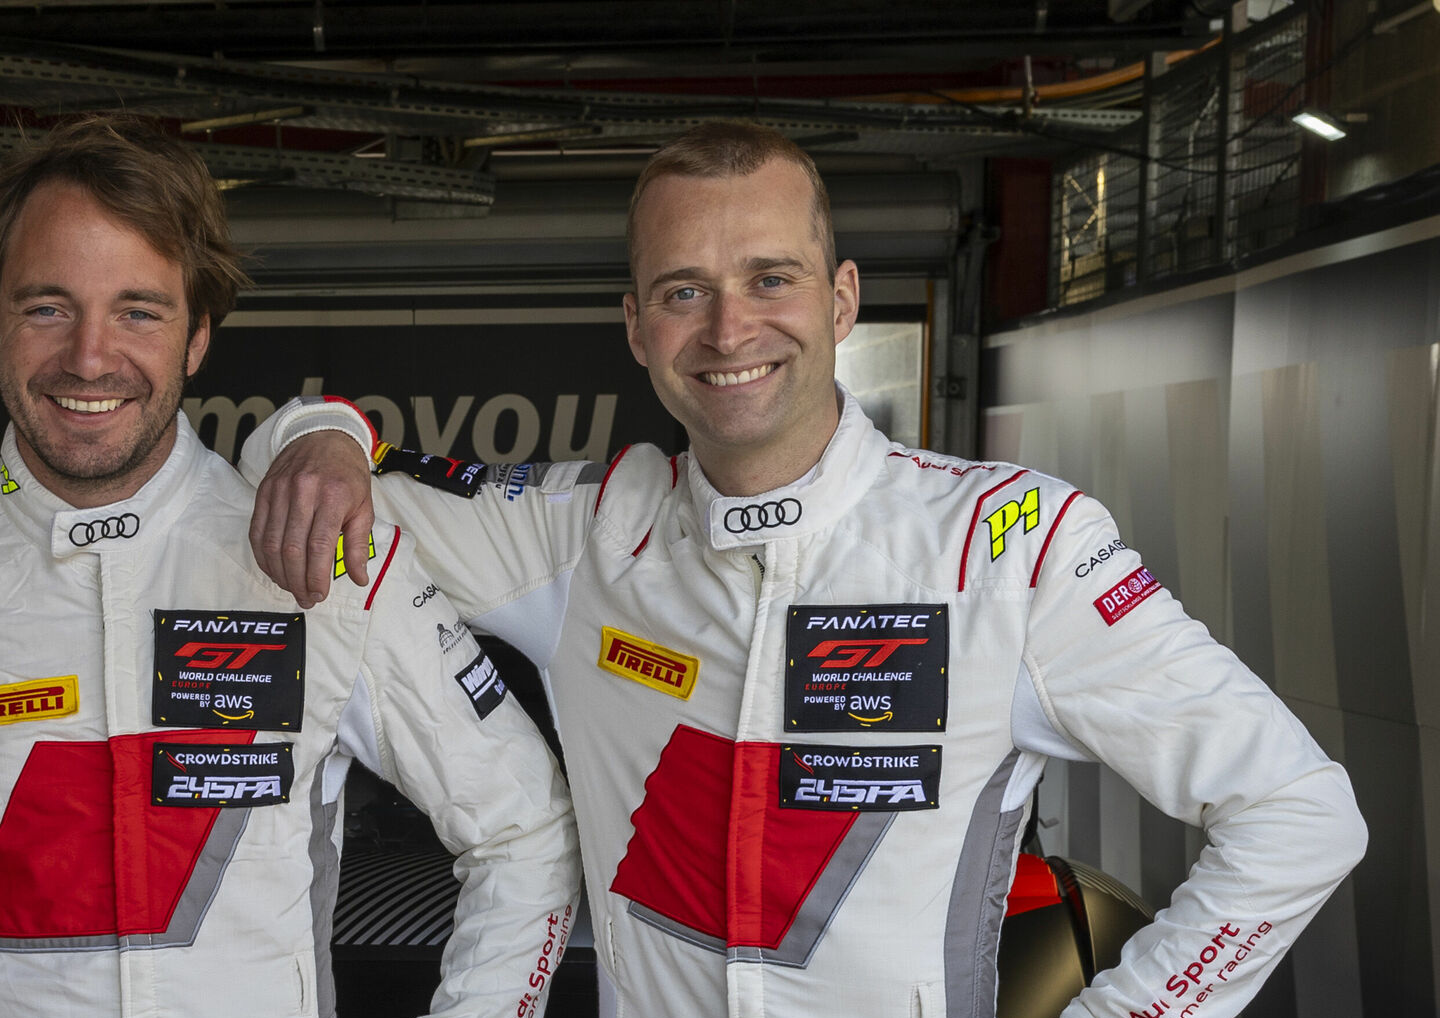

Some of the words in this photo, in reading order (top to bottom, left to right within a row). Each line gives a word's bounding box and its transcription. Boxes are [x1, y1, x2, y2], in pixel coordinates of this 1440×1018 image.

[981, 487, 1040, 563] P1
[1102, 585, 1133, 613] DER
[173, 620, 288, 635] FANATEC
[806, 615, 930, 630] FANATEC
[174, 642, 288, 669] GT
[806, 638, 930, 668] GT
[606, 637, 687, 688] PIRELLI
[179, 671, 214, 681] WORLD
[215, 673, 272, 684] CHALLENGE
[812, 672, 850, 682] WORLD
[851, 672, 912, 682] CHALLENGE
[171, 692, 211, 700] POWERED
[214, 694, 253, 709] aws
[804, 696, 846, 704] POWERED
[850, 695, 892, 710] aws
[175, 752, 278, 766] CROWDSTRIKE
[802, 754, 920, 768] CROWDSTRIKE
[529, 912, 559, 992] Sport
[1216, 920, 1273, 982] racing
[1165, 922, 1241, 998] Sport
